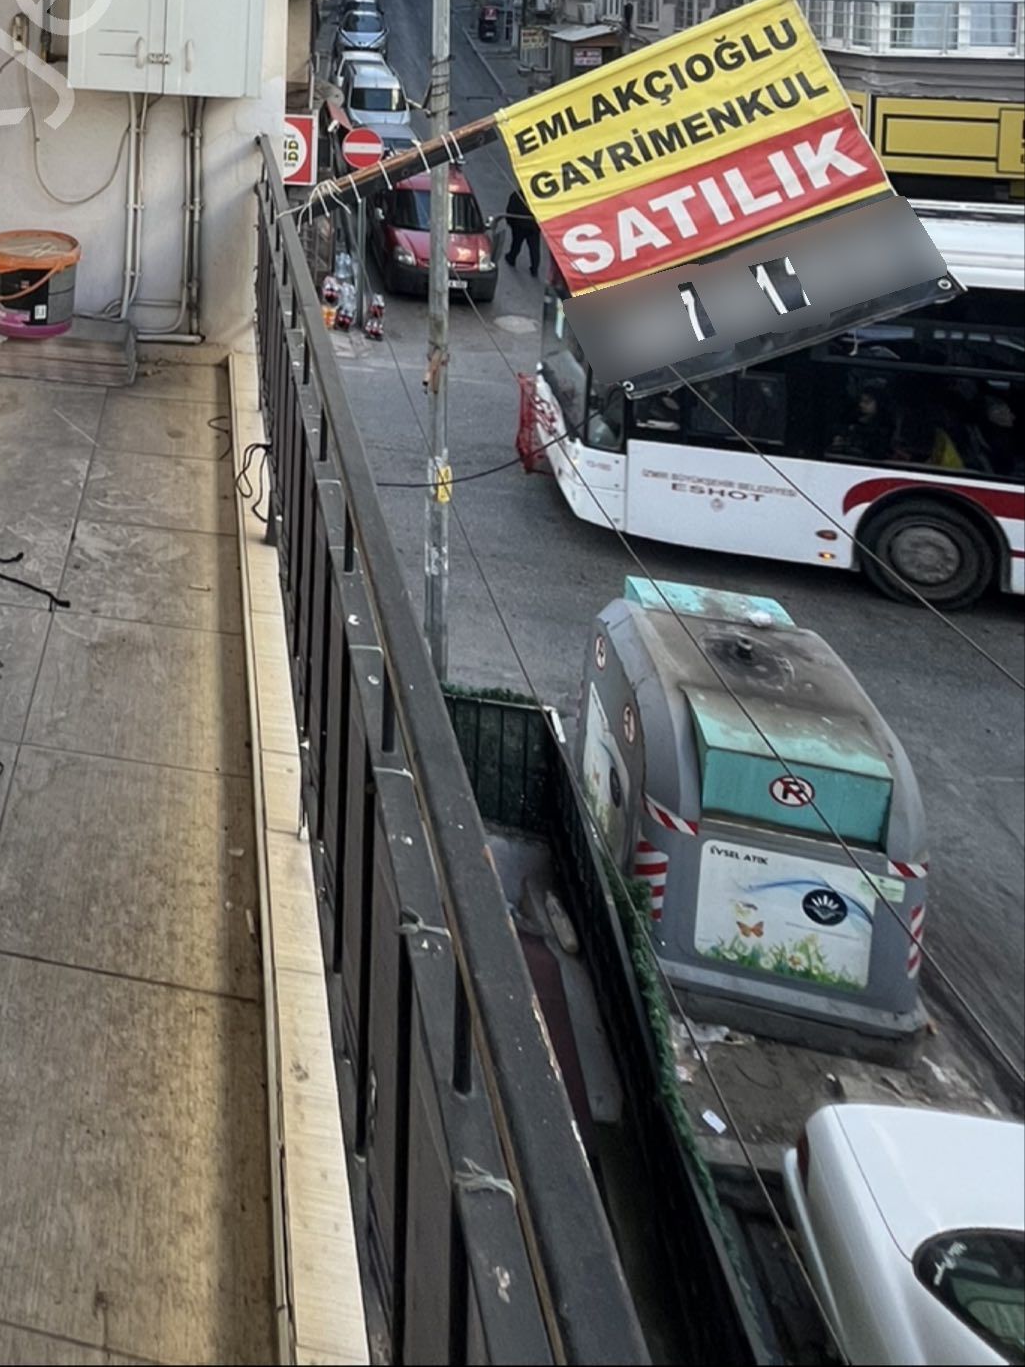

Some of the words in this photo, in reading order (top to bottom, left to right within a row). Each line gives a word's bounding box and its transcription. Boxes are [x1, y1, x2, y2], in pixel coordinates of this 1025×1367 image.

[514, 18, 800, 157] EMLAKÇIOĞLU
[530, 70, 829, 200] GAYRİMENKUL
[562, 127, 868, 274] SATILIK
[672, 483, 765, 501] ESHOT
[709, 845, 740, 860] EVSEL
[744, 853, 768, 865] ATIK
